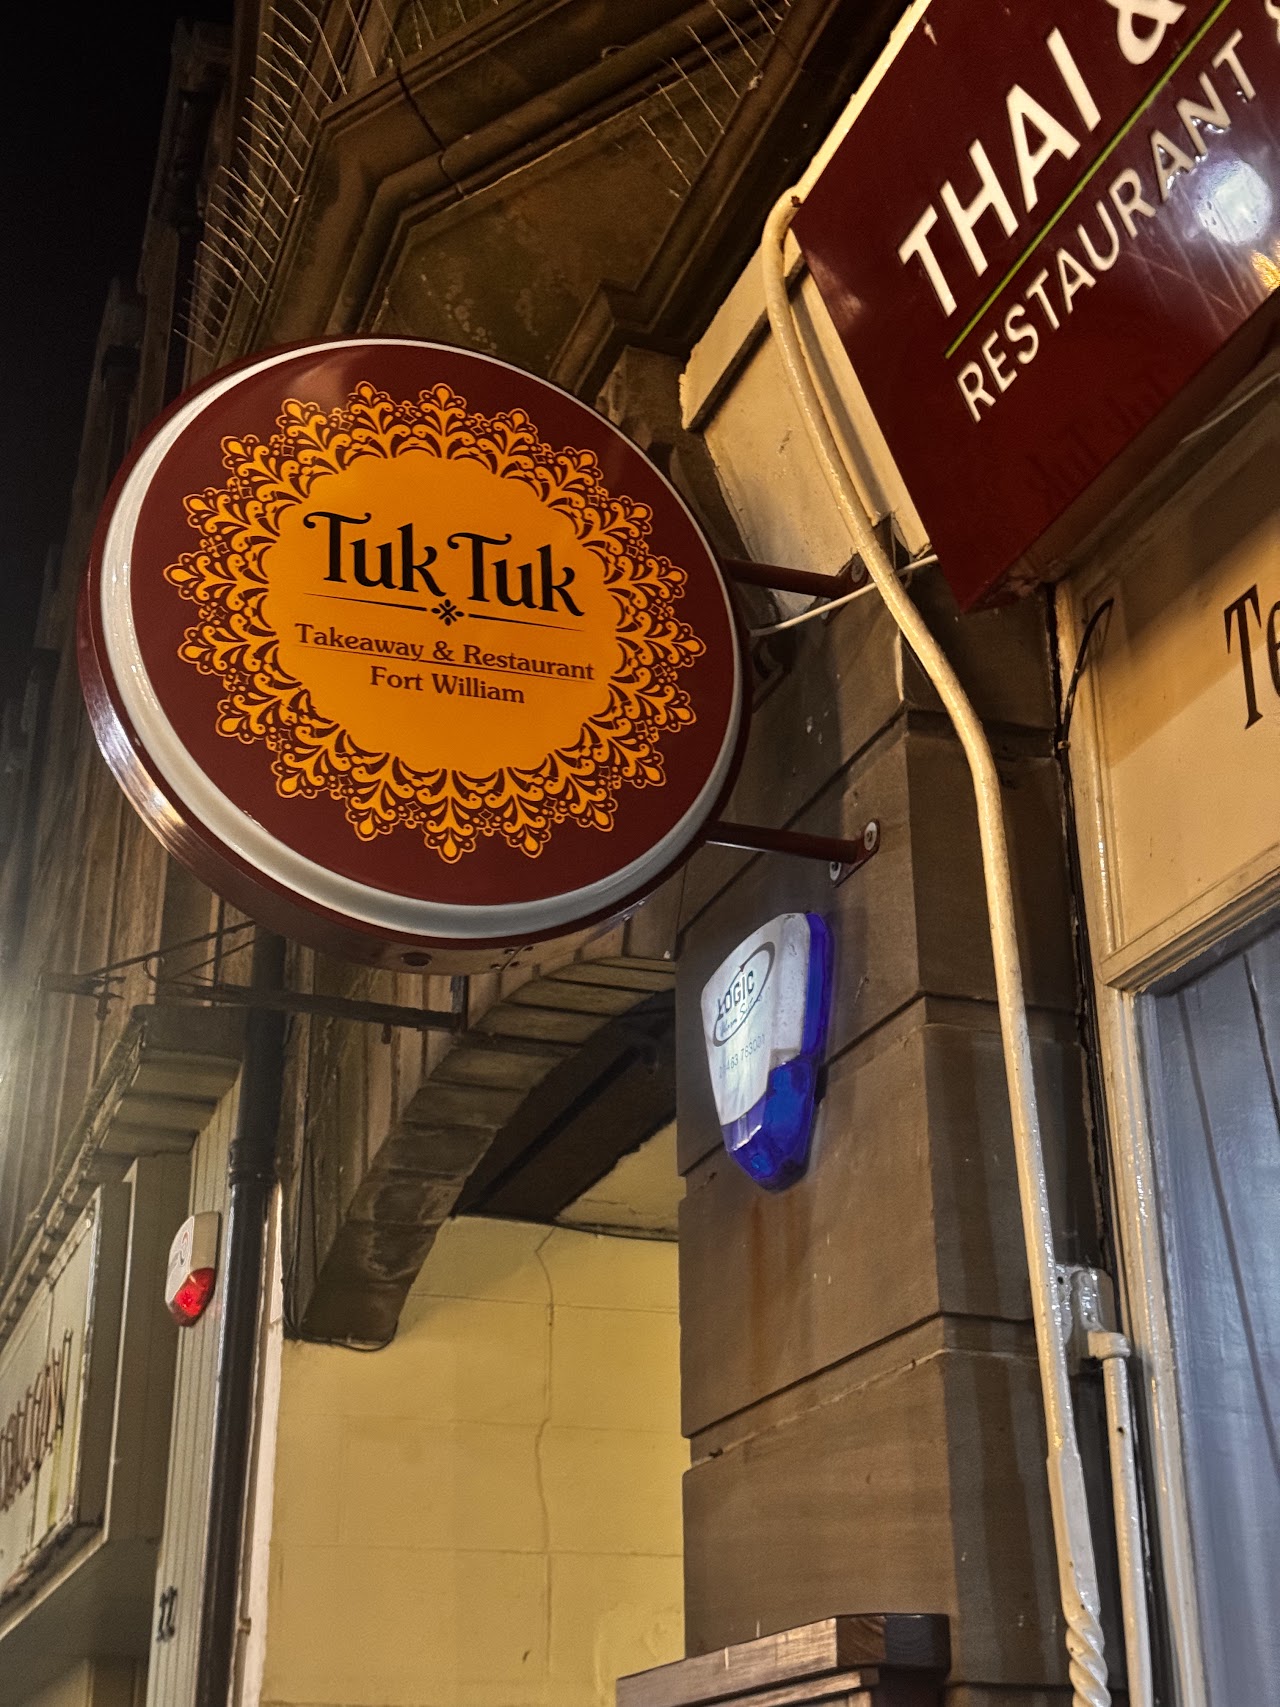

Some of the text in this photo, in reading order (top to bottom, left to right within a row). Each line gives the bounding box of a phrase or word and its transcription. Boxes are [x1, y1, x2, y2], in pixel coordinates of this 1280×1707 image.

[898, 27, 1101, 318] THAI
[956, 29, 1256, 423] RESTAURANT
[303, 511, 585, 616] Tuk Tuk
[294, 622, 595, 681] Takeaway & Restaurant
[370, 666, 525, 703] Fort William
[717, 969, 755, 1021] LOGIC
